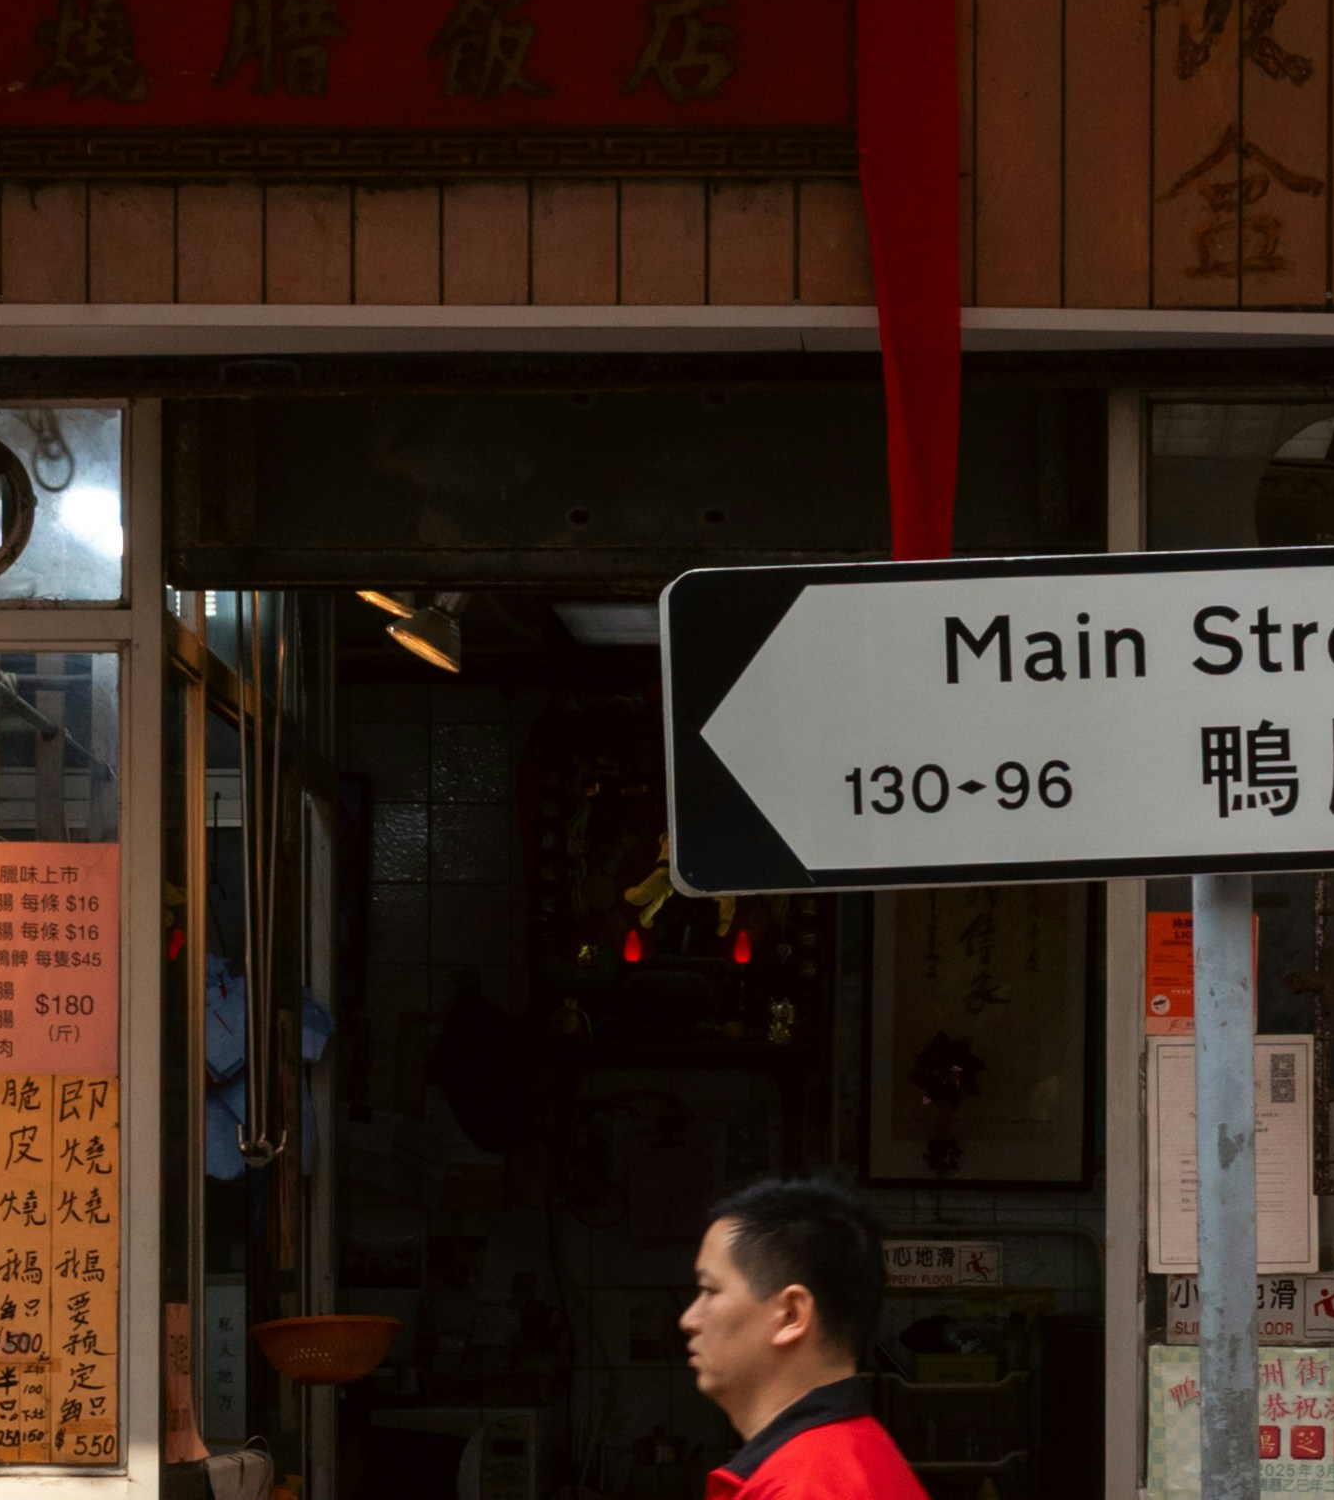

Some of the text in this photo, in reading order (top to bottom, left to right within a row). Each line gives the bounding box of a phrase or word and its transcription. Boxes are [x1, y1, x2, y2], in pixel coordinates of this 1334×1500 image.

[944, 612, 1147, 686] Main
[0, 864, 79, 885] 臘味上市
[20, 894, 60, 913] 每條
[66, 895, 99, 913] $16
[20, 922, 60, 941] 每條
[66, 923, 99, 941] $16
[34, 992, 94, 1017] $180
[921, 1274, 954, 1286] FLOOR
[1257, 1321, 1295, 1336] LOOR
